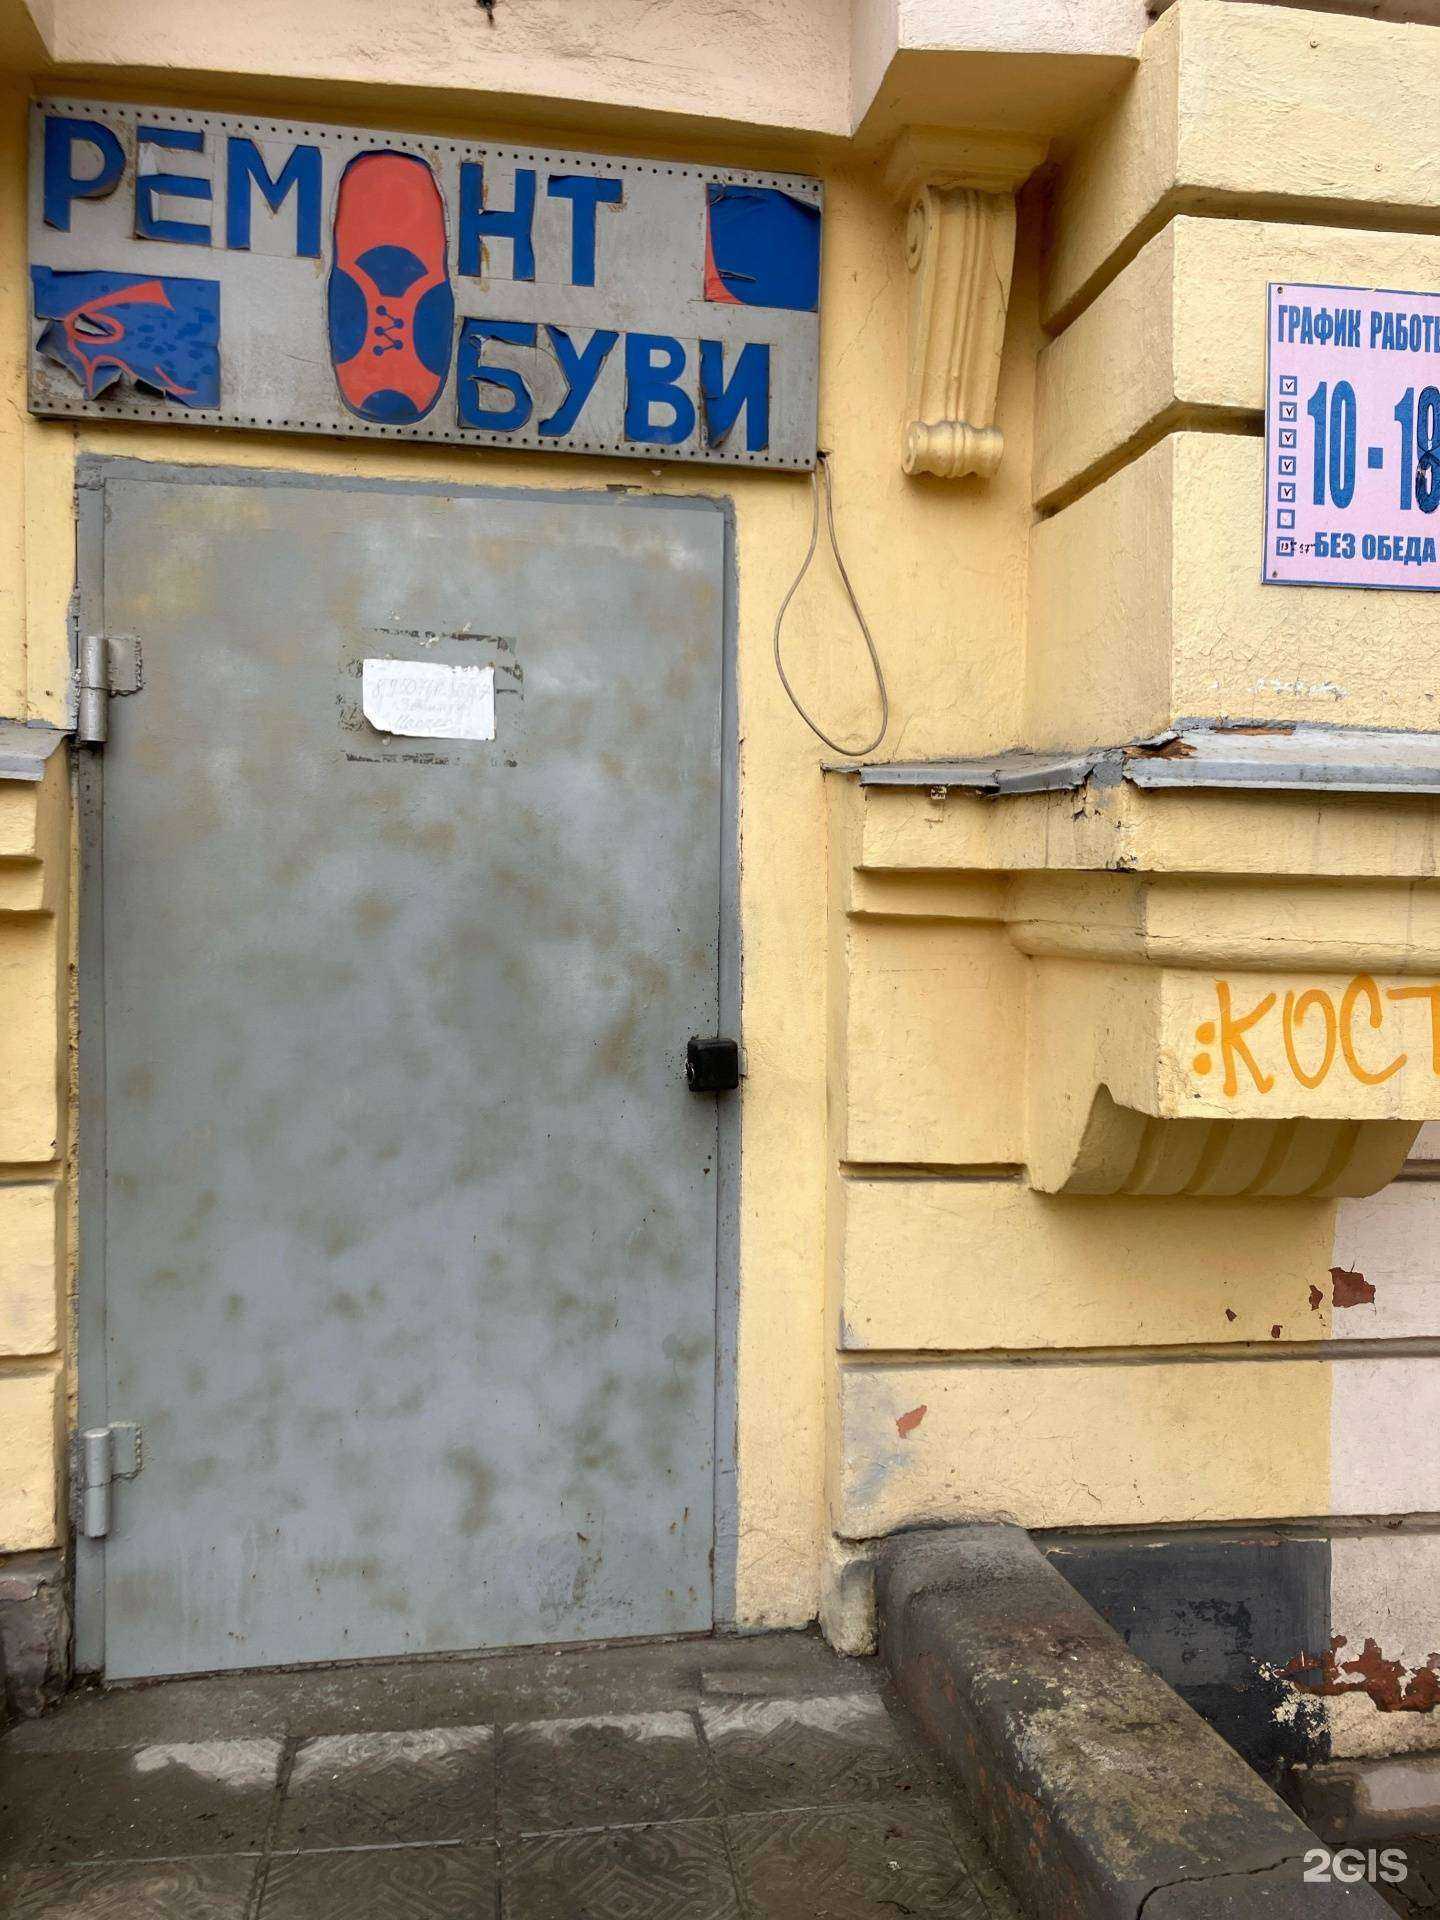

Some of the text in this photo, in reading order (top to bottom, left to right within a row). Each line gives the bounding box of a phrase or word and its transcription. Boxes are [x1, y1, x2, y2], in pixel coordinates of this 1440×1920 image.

[1278, 304, 1361, 348] ГРАФИК
[1307, 379, 1356, 509] 10
[1314, 531, 1356, 560] БЕЗ
[1361, 534, 1437, 566] ОБЕДА
